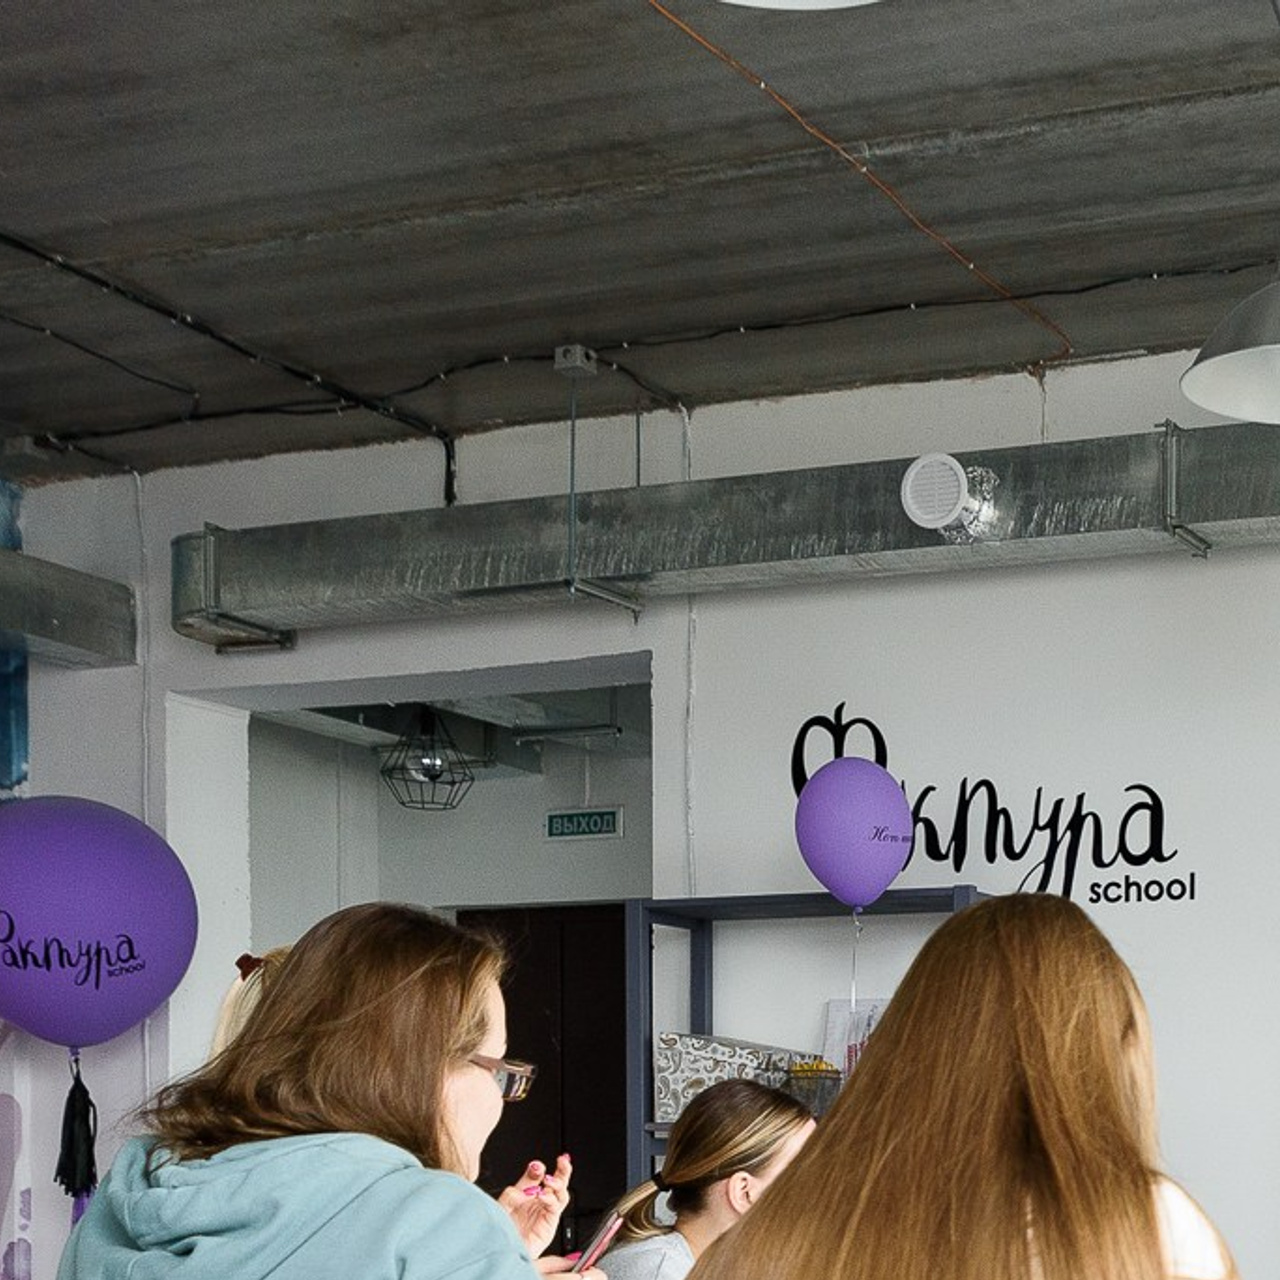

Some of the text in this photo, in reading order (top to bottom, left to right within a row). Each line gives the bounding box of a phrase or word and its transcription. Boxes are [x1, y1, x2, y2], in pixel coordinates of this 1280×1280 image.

[552, 814, 614, 834] ВЫХОД
[1089, 872, 1195, 903] school
[107, 961, 146, 978] school
